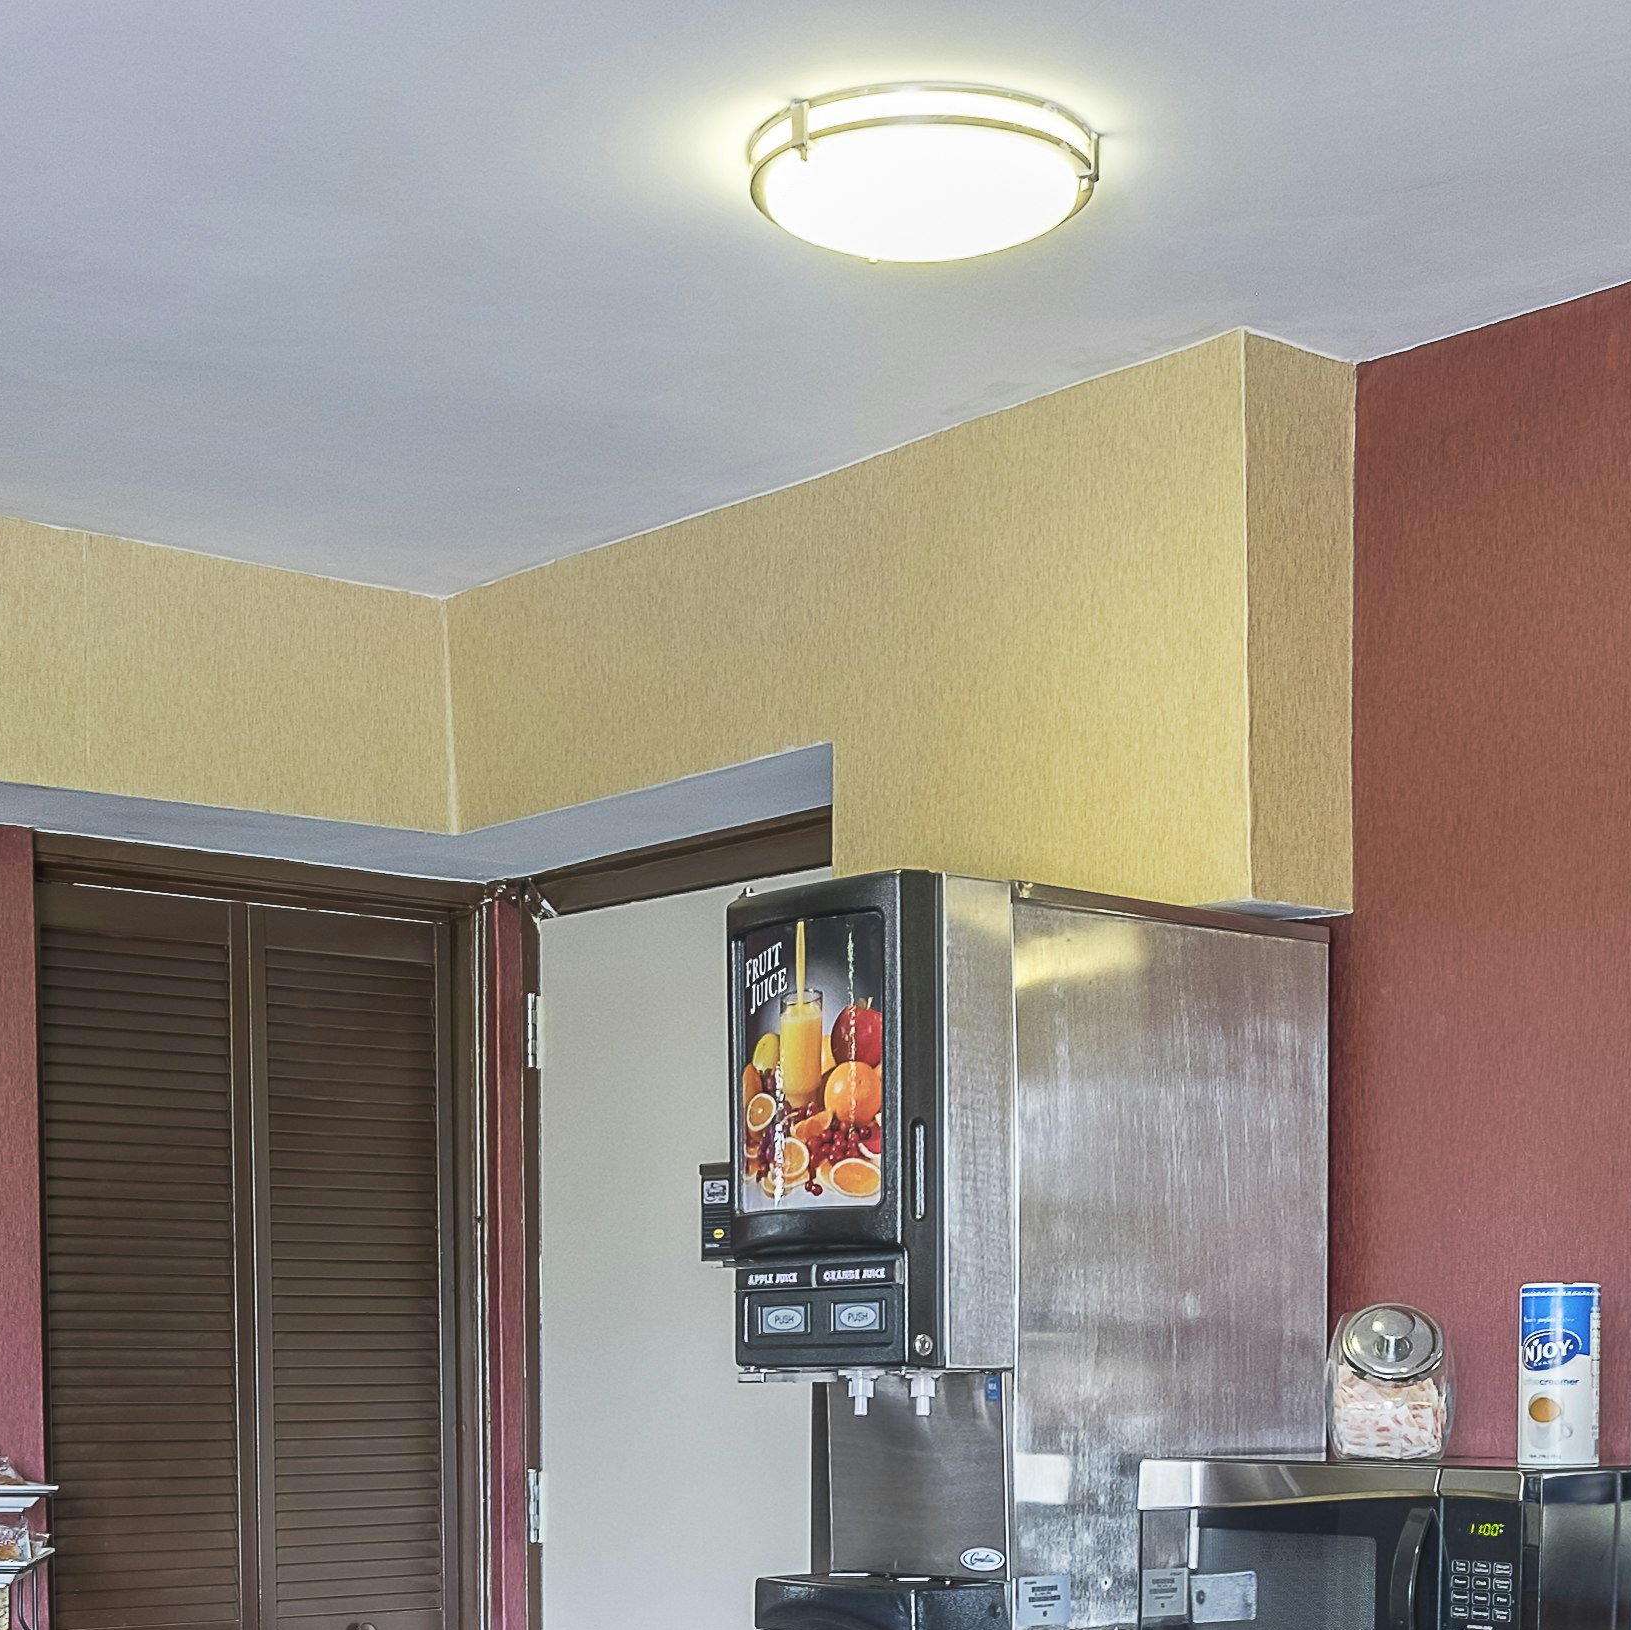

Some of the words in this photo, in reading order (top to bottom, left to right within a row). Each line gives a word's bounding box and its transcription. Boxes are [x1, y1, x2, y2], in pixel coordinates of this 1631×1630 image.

[746, 941, 782, 988] FRUIT
[750, 967, 787, 1015] JUICE
[748, 1273, 773, 1285] APPLE
[775, 1272, 798, 1284] JUICE
[823, 1269, 860, 1281] ORANGE
[862, 1267, 886, 1279] JUICE
[774, 1315, 795, 1324] PUSH
[847, 1312, 868, 1321] PUSH
